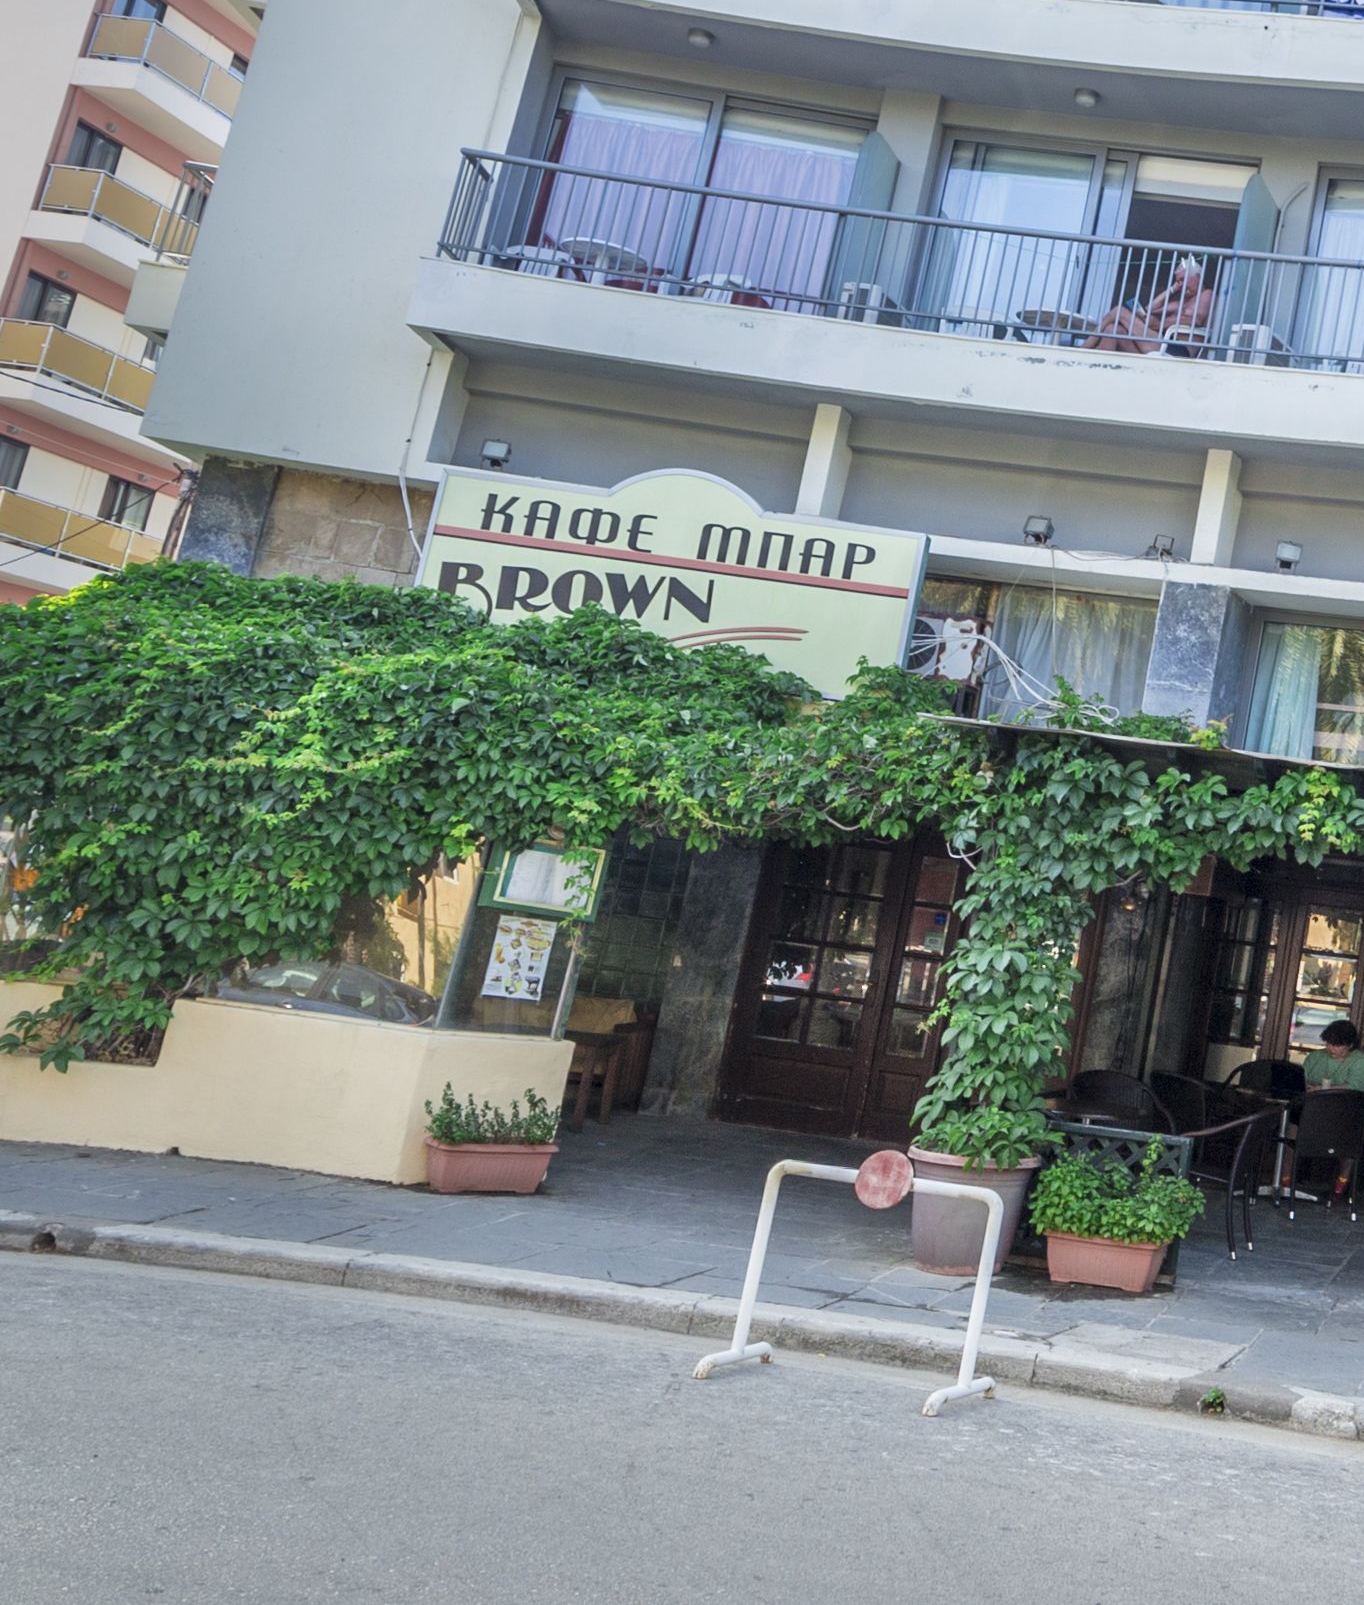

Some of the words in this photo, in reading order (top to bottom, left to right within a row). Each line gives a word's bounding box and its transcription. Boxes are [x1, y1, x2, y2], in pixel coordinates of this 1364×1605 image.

[481, 493, 658, 554] ΚΑΦΕ
[697, 523, 876, 580] ΜΠΑΡ
[438, 561, 715, 624] BROWN
